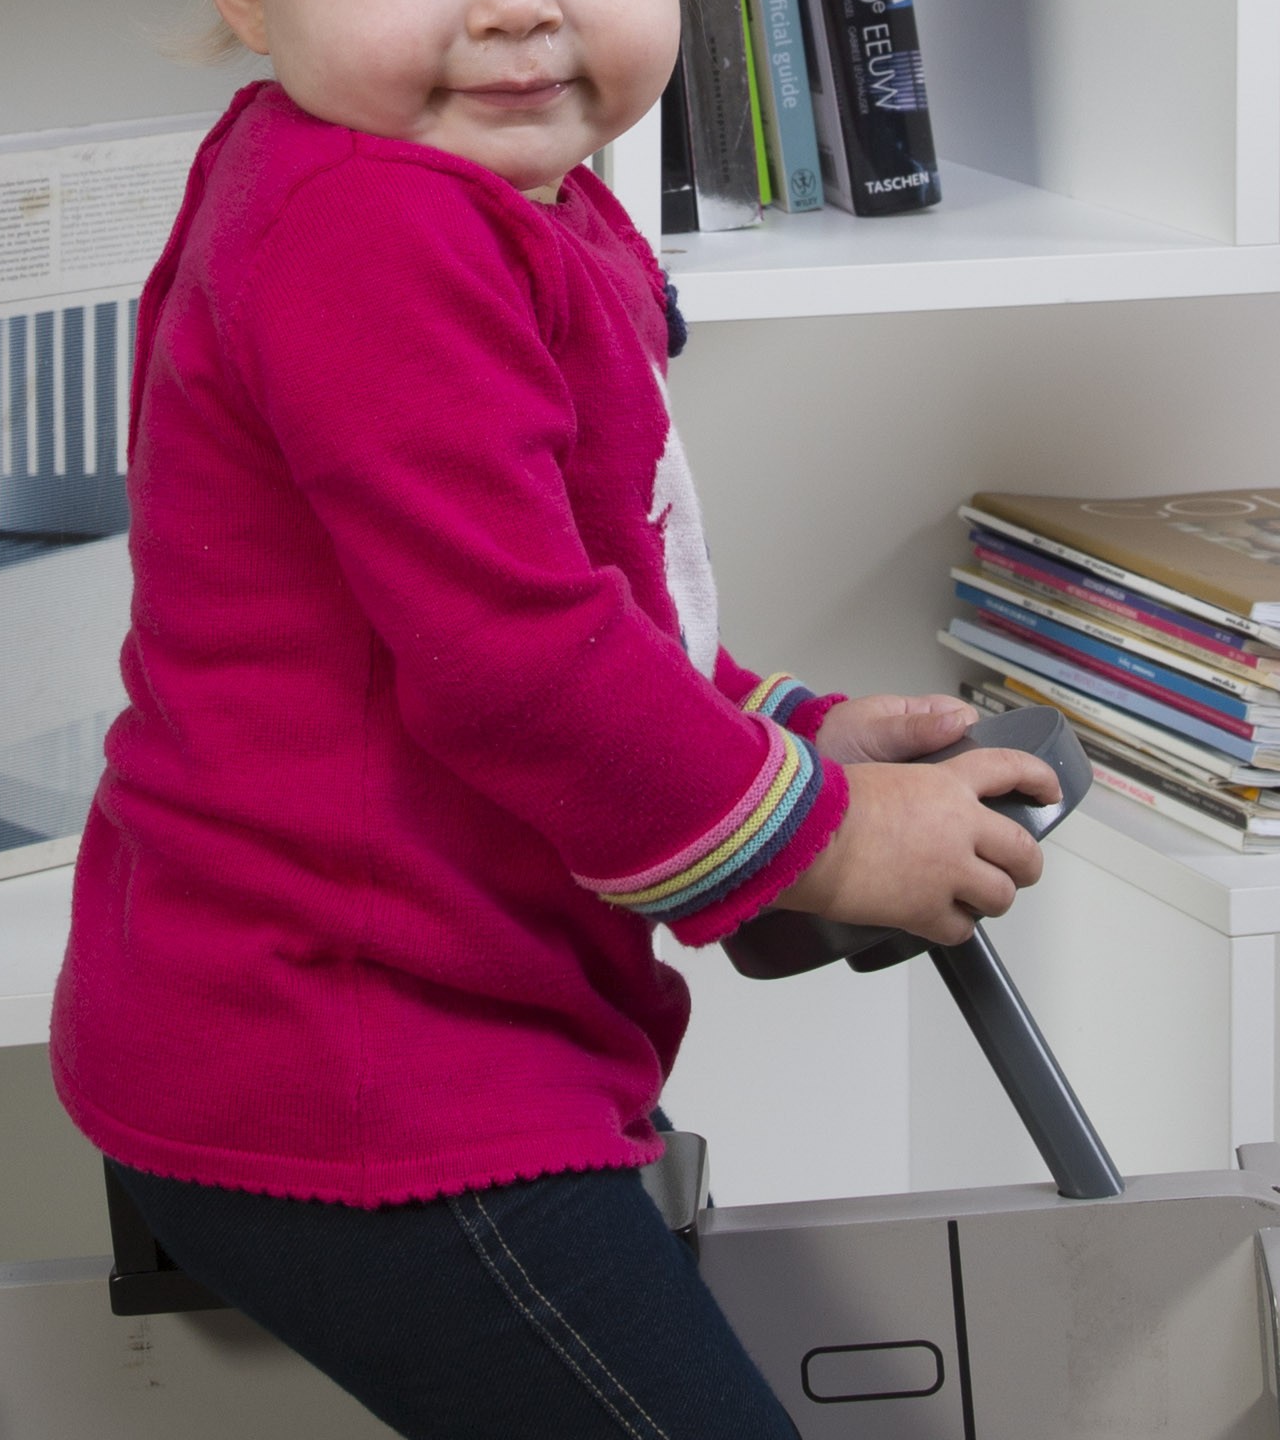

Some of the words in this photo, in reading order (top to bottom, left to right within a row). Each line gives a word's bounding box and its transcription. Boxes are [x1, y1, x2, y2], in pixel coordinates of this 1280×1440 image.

[772, 51, 798, 110] guide
[863, 23, 902, 110] EEUW
[865, 171, 930, 194] TASCHEN
